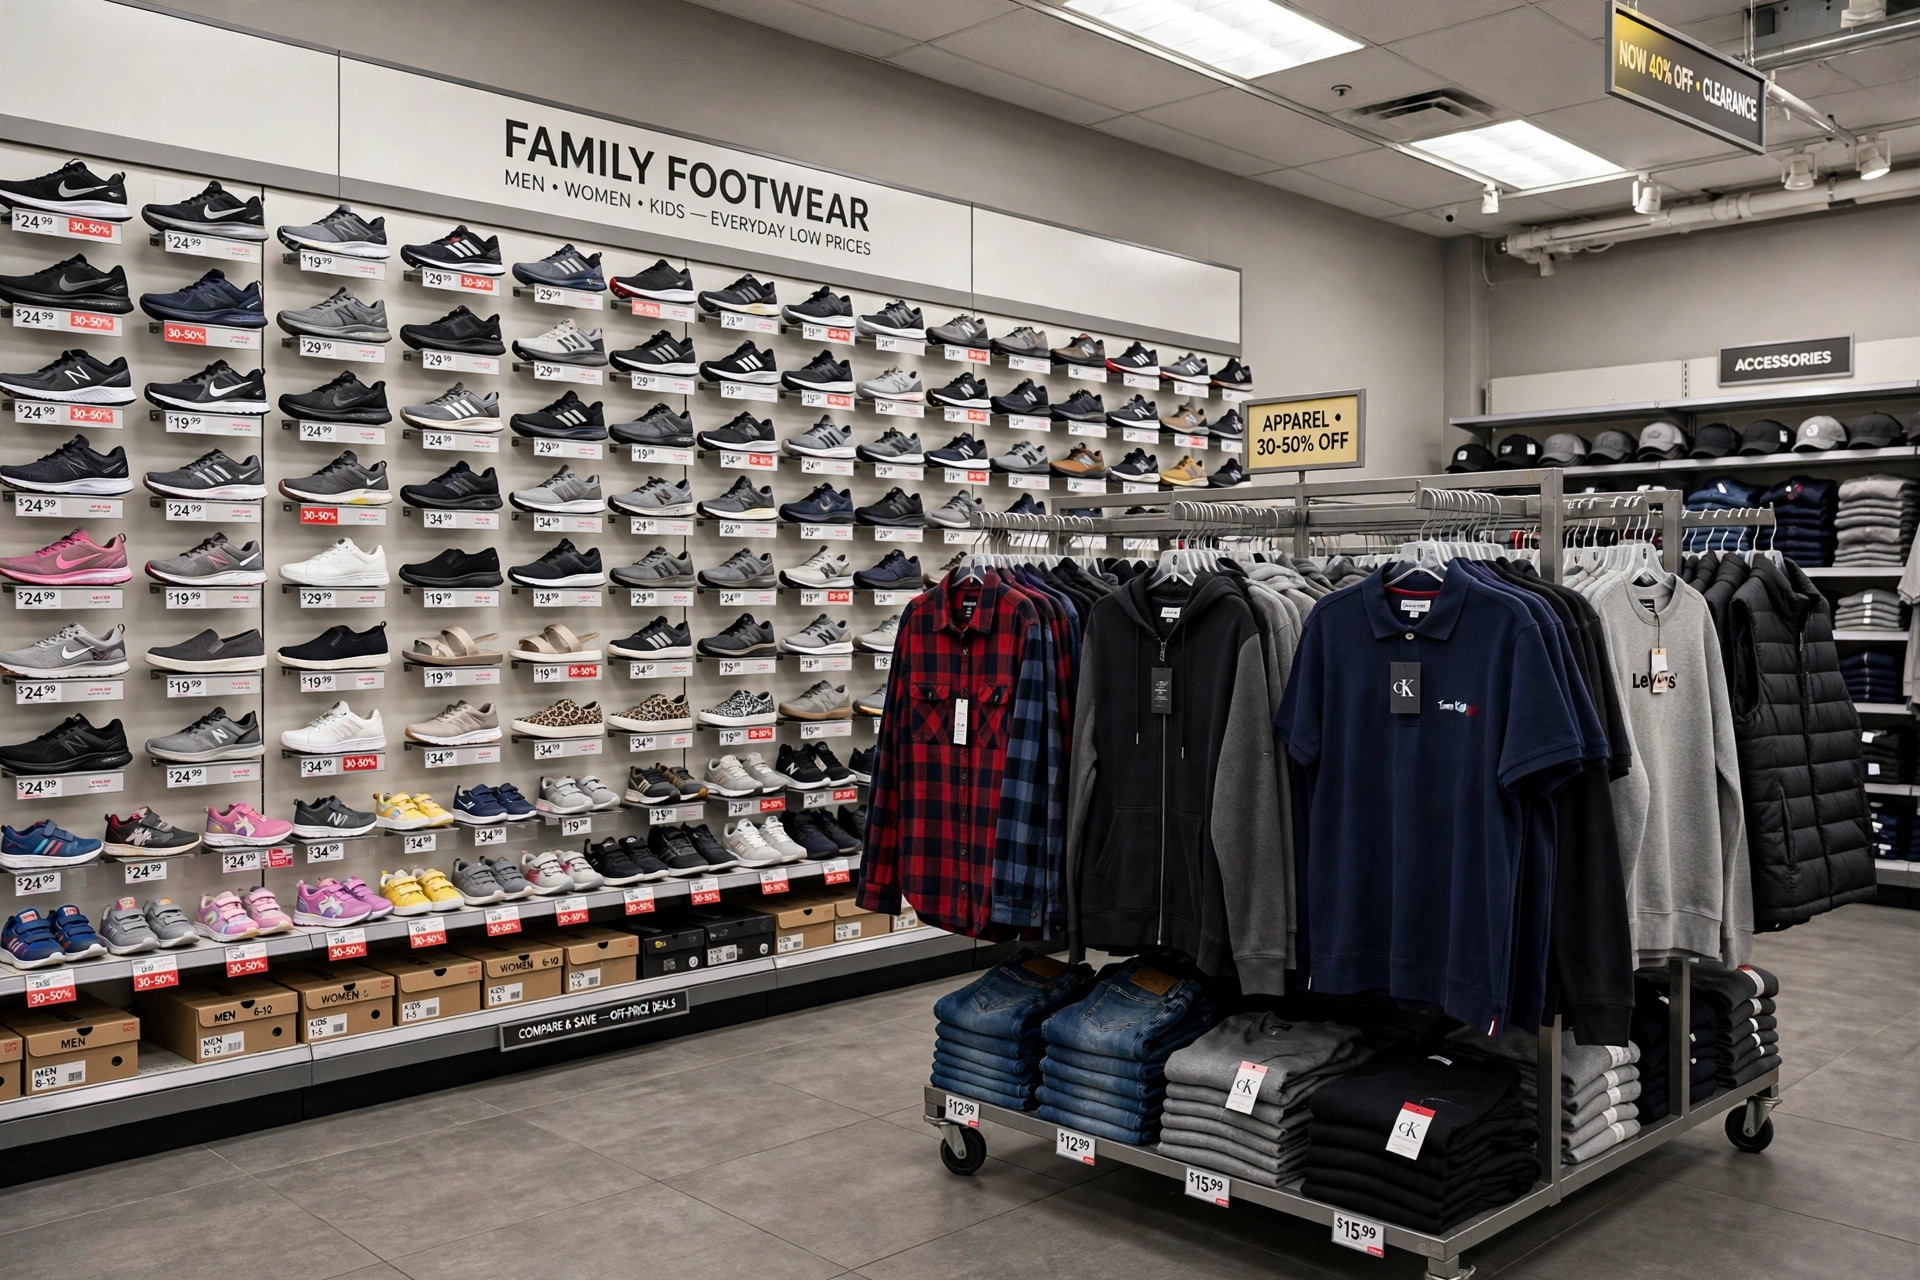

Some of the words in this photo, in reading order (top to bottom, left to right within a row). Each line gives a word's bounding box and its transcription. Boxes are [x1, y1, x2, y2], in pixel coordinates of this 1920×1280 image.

[1620, 40, 1646, 74] NOW
[1650, 54, 1672, 85] 40%
[1674, 65, 1693, 93] OFF
[1703, 78, 1756, 121] CLEARANCE
[505, 118, 655, 185] FAMILY
[668, 154, 870, 232] FOOTWEAR
[506, 169, 544, 192] MEN
[565, 179, 632, 208] WOMEN
[650, 198, 684, 219] KIDS
[712, 209, 785, 238] EVERYDAY
[790, 227, 821, 245] LOW
[826, 234, 870, 255] PRICES
[69, 220, 112, 237] 30-50%
[71, 313, 114, 330] 30-50%
[169, 325, 206, 340] 30-50%
[1735, 351, 1831, 371] ACCESSORIES
[70, 409, 111, 422] 30-50%
[1263, 410, 1329, 432] APPAREL
[1257, 435, 1314, 455] 30-50%
[1319, 431, 1348, 450] OFF
[304, 511, 336, 520] 30-50%
[331, 946, 365, 958] 30-50%
[230, 961, 264, 973] 30-50%
[500, 961, 534, 973] WOMEN
[138, 975, 174, 987] 30-50%
[29, 988, 71, 1003] 30-50%
[321, 991, 359, 1005] WOMEN
[215, 1010, 235, 1022] MEN
[518, 1021, 564, 1039] COMPARE
[565, 1019, 572, 1030] &
[574, 1014, 597, 1029] SAVE
[61, 1037, 85, 1049] MEN
[1190, 1169, 1224, 1192] $15.99
[1337, 1215, 1377, 1240] $15.99
